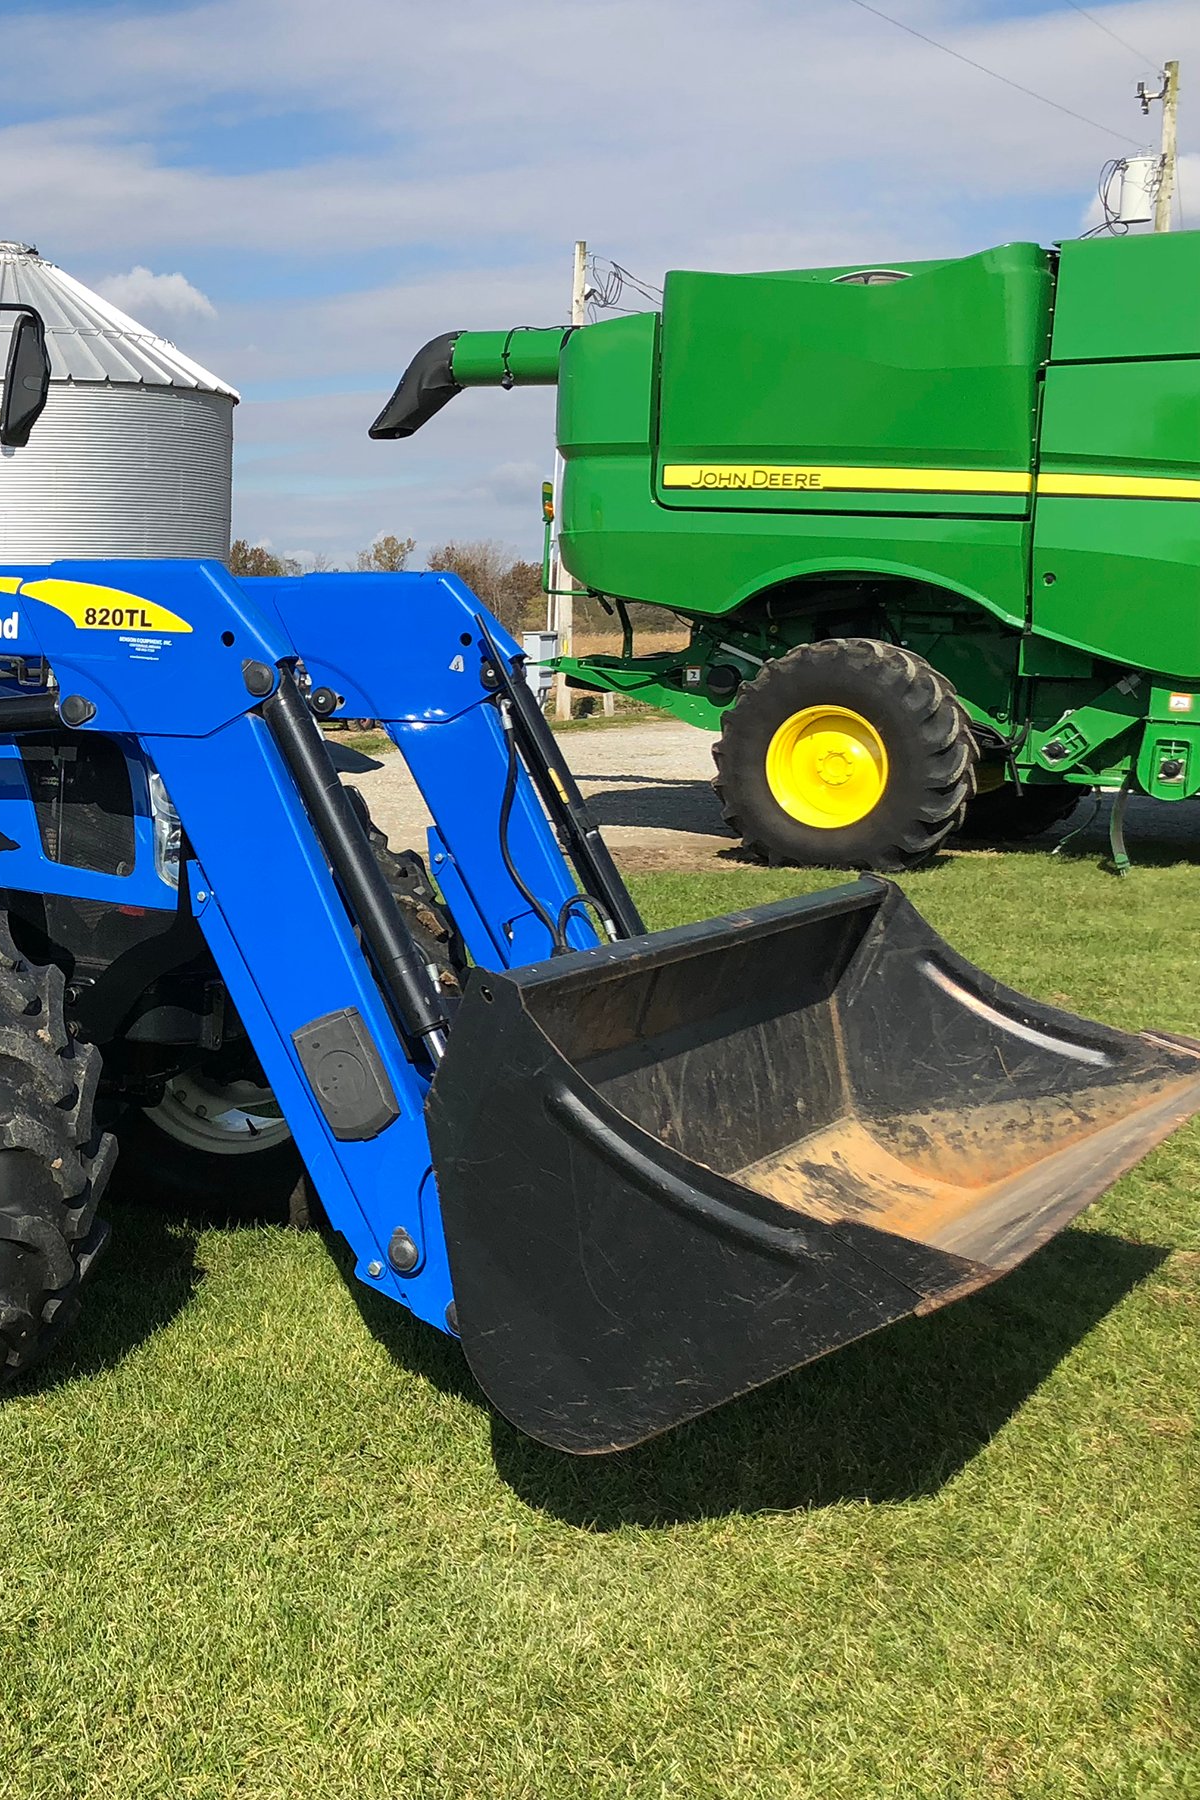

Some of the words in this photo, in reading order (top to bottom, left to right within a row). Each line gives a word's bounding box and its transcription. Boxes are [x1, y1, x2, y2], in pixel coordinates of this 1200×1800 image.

[691, 469, 747, 486] JOHN
[752, 470, 822, 487] DEERE
[84, 607, 152, 628] 820TL
